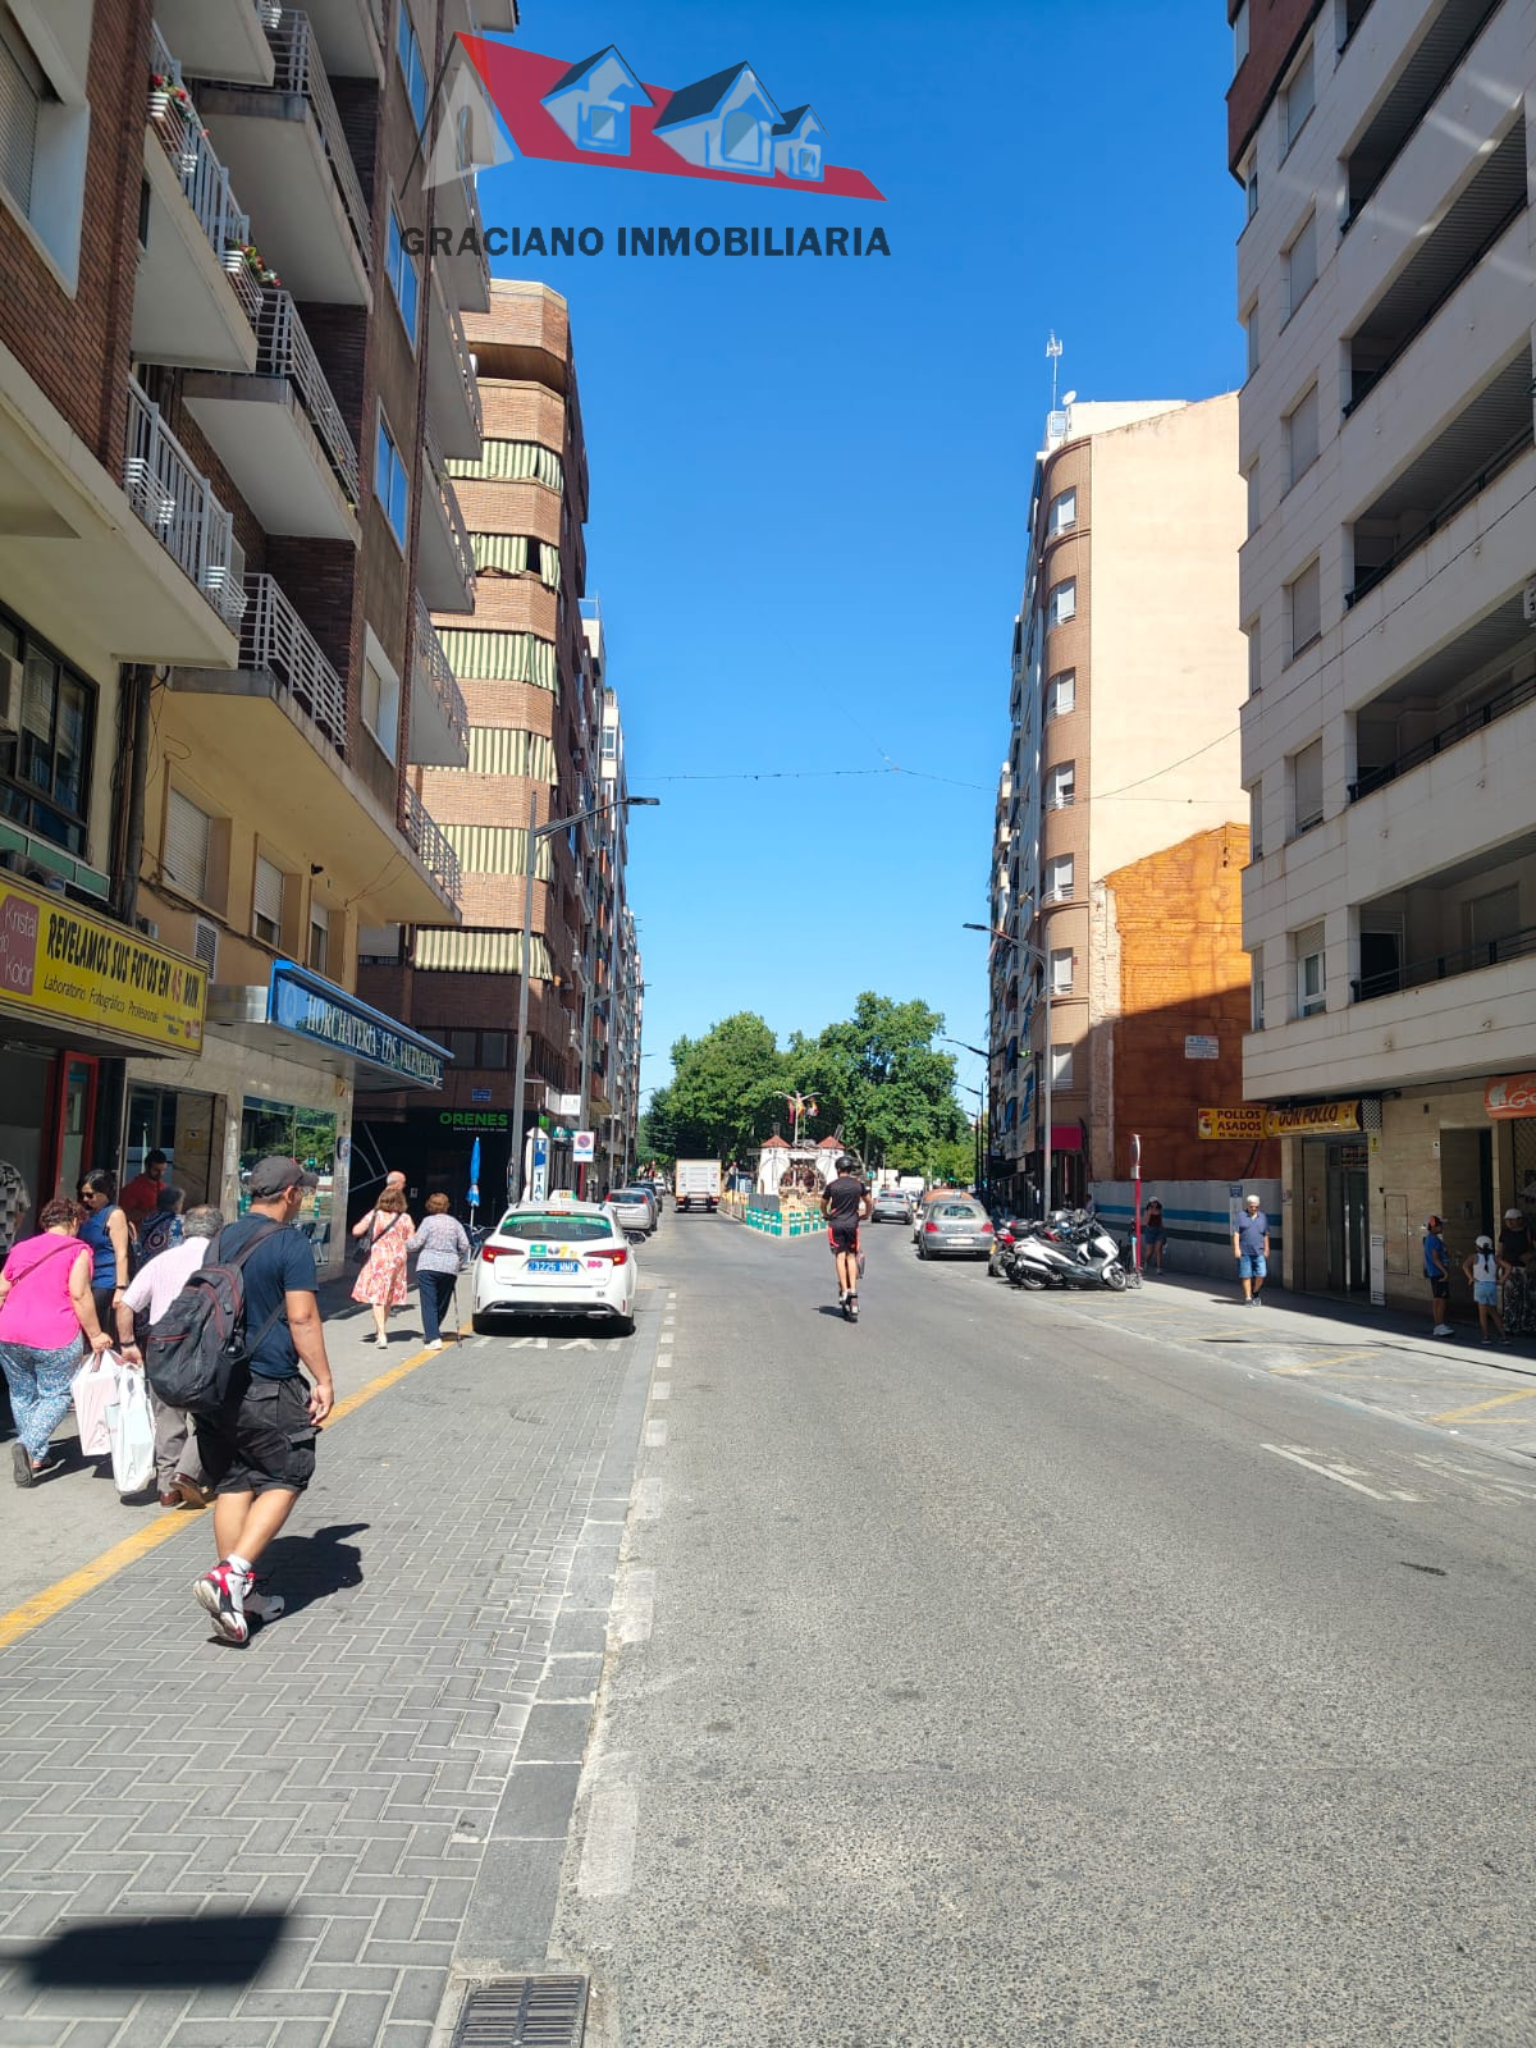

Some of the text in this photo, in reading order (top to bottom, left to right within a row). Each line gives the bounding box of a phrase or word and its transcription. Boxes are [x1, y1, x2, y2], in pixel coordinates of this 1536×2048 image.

[5, 901, 37, 939] Kristal
[47, 912, 112, 976] REVELAMOS
[111, 940, 131, 984] SUS
[131, 947, 159, 994] FOTOS
[158, 959, 172, 998] EN
[44, 973, 87, 1001] Laboratorio
[440, 1112, 508, 1126] ORENES
[1217, 1109, 1261, 1120] POLLOS
[1217, 1120, 1261, 1131] ASADOS
[1279, 1104, 1338, 1127] DON POLLO
